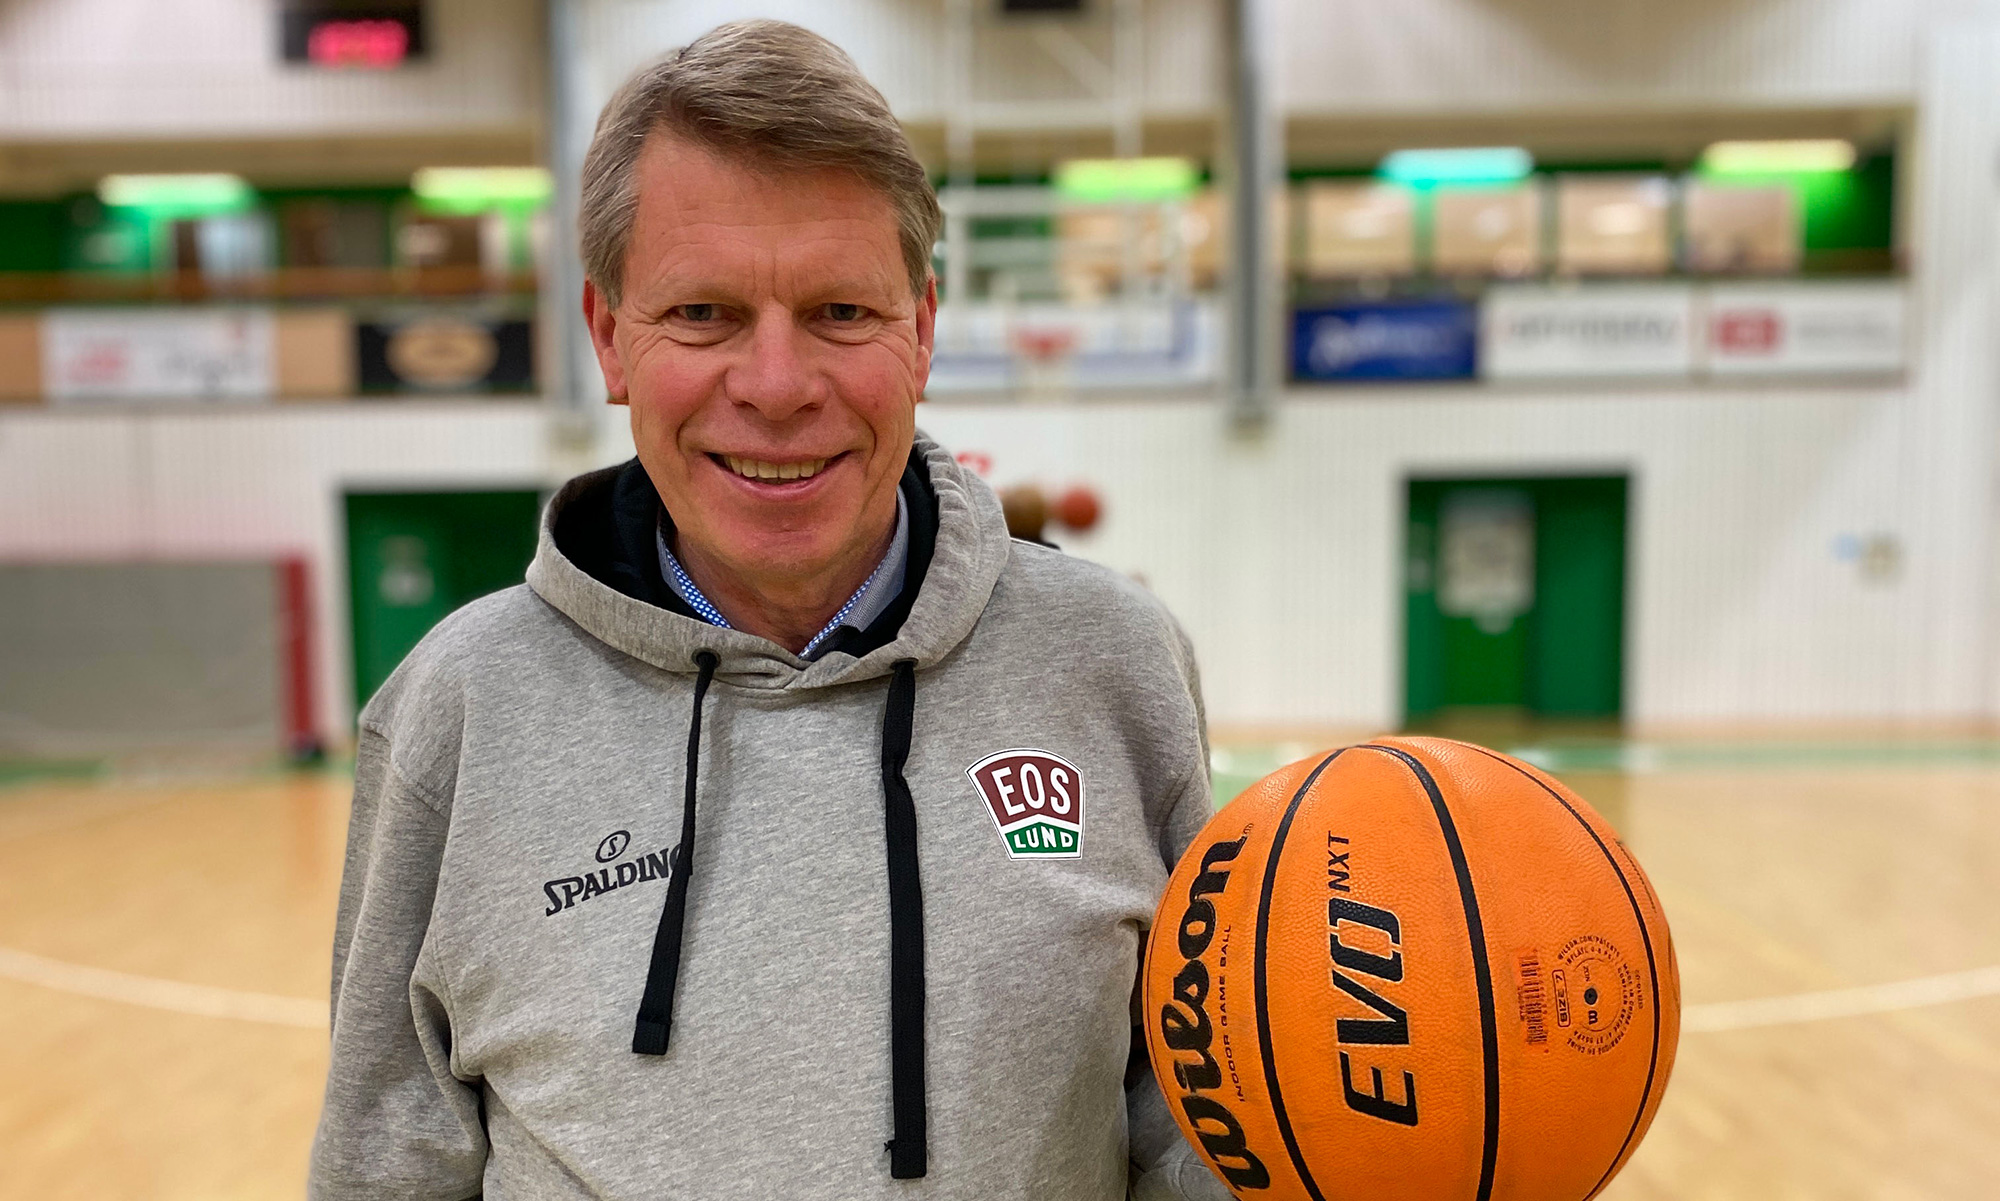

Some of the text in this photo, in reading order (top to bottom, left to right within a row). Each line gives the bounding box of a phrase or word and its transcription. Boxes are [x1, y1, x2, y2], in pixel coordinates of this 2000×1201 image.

[991, 762, 1071, 817] EOS
[1013, 825, 1074, 849] LUND
[1327, 830, 1418, 1127] EVO NXT
[1557, 989, 1568, 1022] SIZE
[1218, 925, 1245, 1102] INDOOR GAME BALL
